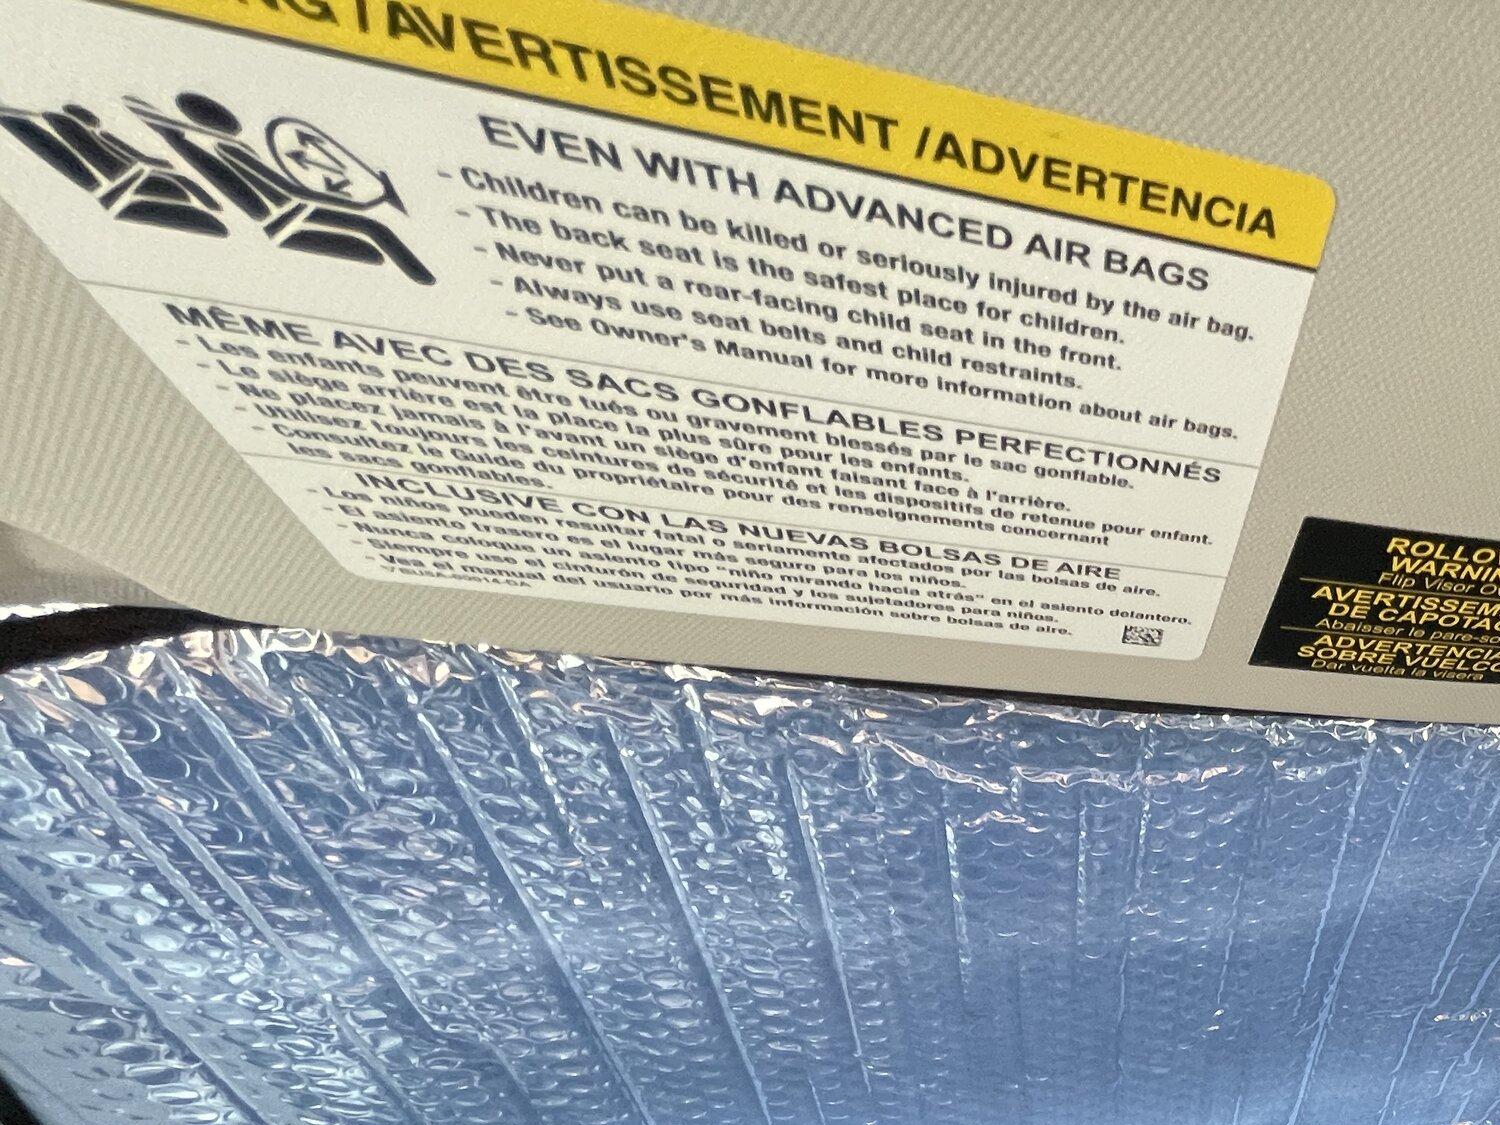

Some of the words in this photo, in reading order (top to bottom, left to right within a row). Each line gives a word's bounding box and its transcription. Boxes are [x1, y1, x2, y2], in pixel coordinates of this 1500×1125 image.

[459, 165, 604, 215] Children
[611, 200, 671, 228] can
[677, 208, 719, 236] be
[725, 218, 809, 254] killed
[817, 240, 848, 261] or
[855, 248, 981, 291] seriously
[988, 270, 1078, 307] injured
[1085, 290, 1115, 317] by
[1122, 298, 1162, 323] the
[1167, 310, 1201, 330] air
[1206, 315, 1254, 343] bag.
[476, 112, 624, 173] EVEN
[631, 146, 760, 201] WITH
[773, 176, 1014, 251] ADVANCED
[1023, 232, 1091, 270] AIR
[1103, 247, 1210, 292] BAGS
[474, 204, 543, 237] The
[549, 217, 632, 253] back
[637, 239, 706, 267] seat
[711, 248, 740, 273] is
[746, 255, 795, 283] the
[802, 269, 890, 301] safest
[896, 287, 968, 315] place
[975, 299, 1013, 324] for
[1019, 310, 1125, 345] children.
[493, 240, 586, 276] Never
[594, 263, 650, 288] put
[655, 274, 675, 292] a
[682, 278, 839, 324] rear-facing
[846, 307, 912, 334] child
[919, 322, 976, 345] seat
[982, 328, 1005, 350] in
[1012, 336, 1052, 359] the
[1058, 344, 1122, 372] front.
[513, 275, 623, 312] Always
[630, 299, 684, 322] use
[690, 310, 754, 334] seat
[758, 317, 828, 346] belts
[835, 334, 884, 356] and
[890, 343, 953, 368] child
[960, 356, 1083, 390] restraints.
[161, 302, 322, 347] MÊME
[332, 329, 454, 368] AVEC
[463, 350, 555, 384] DES
[565, 368, 680, 403] SACS
[690, 386, 944, 443] GONFLABLES
[955, 428, 1222, 484] PERFECTIONNÉS
[195, 333, 261, 360] Les
[266, 349, 386, 379] enfants
[391, 368, 511, 398] peuvent
[515, 384, 573, 407] être
[578, 394, 641, 418] tués
[645, 407, 679, 424] ou
[685, 413, 820, 444] gravement
[824, 431, 914, 458] blessés
[919, 448, 958, 464] par
[963, 451, 984, 468] le
[989, 458, 1028, 474] sac
[1033, 464, 1134, 490] gonflable.
[524, 306, 583, 332] See
[588, 317, 708, 353] Owner's
[713, 337, 814, 371] Manual
[820, 355, 858, 377] for
[865, 366, 929, 390] more
[936, 375, 1072, 413] information
[1078, 401, 1143, 425] about
[1147, 413, 1179, 429] air
[1182, 417, 1238, 440] bags.
[354, 471, 564, 514] INCLUSIVE
[571, 501, 651, 525] CON
[659, 512, 729, 534] LAS
[737, 522, 869, 551] NUEVAS
[878, 539, 1002, 567] BOLSAS
[1010, 555, 1049, 572] DE
[1054, 561, 1122, 581] AIRE
[1296, 645, 1398, 665] SOBRE
[1327, 602, 1372, 620] DE
